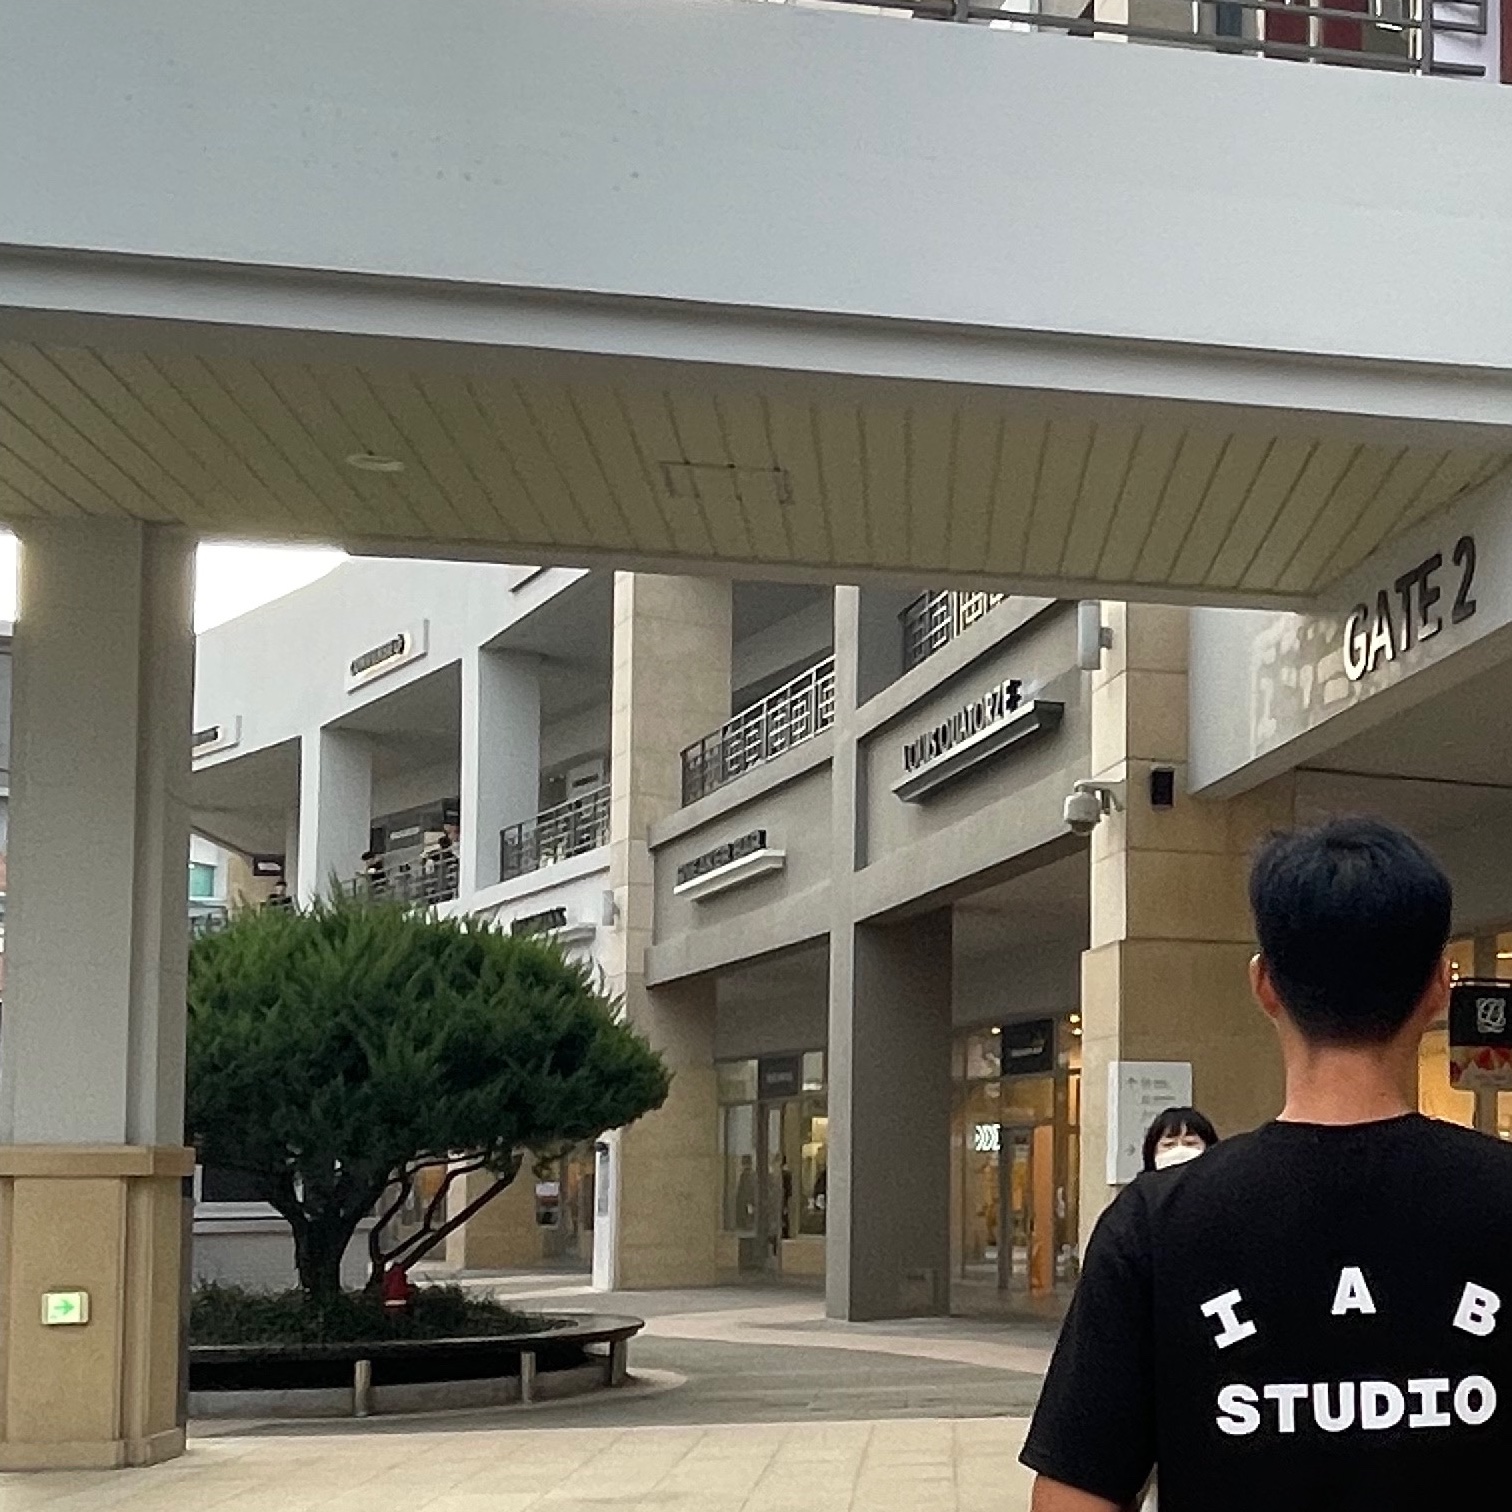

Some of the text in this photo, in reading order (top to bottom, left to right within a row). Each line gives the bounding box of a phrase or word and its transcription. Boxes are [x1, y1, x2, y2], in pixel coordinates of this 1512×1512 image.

[1343, 535, 1477, 681] GATE 2
[1215, 1375, 1497, 1435] STUDIO
